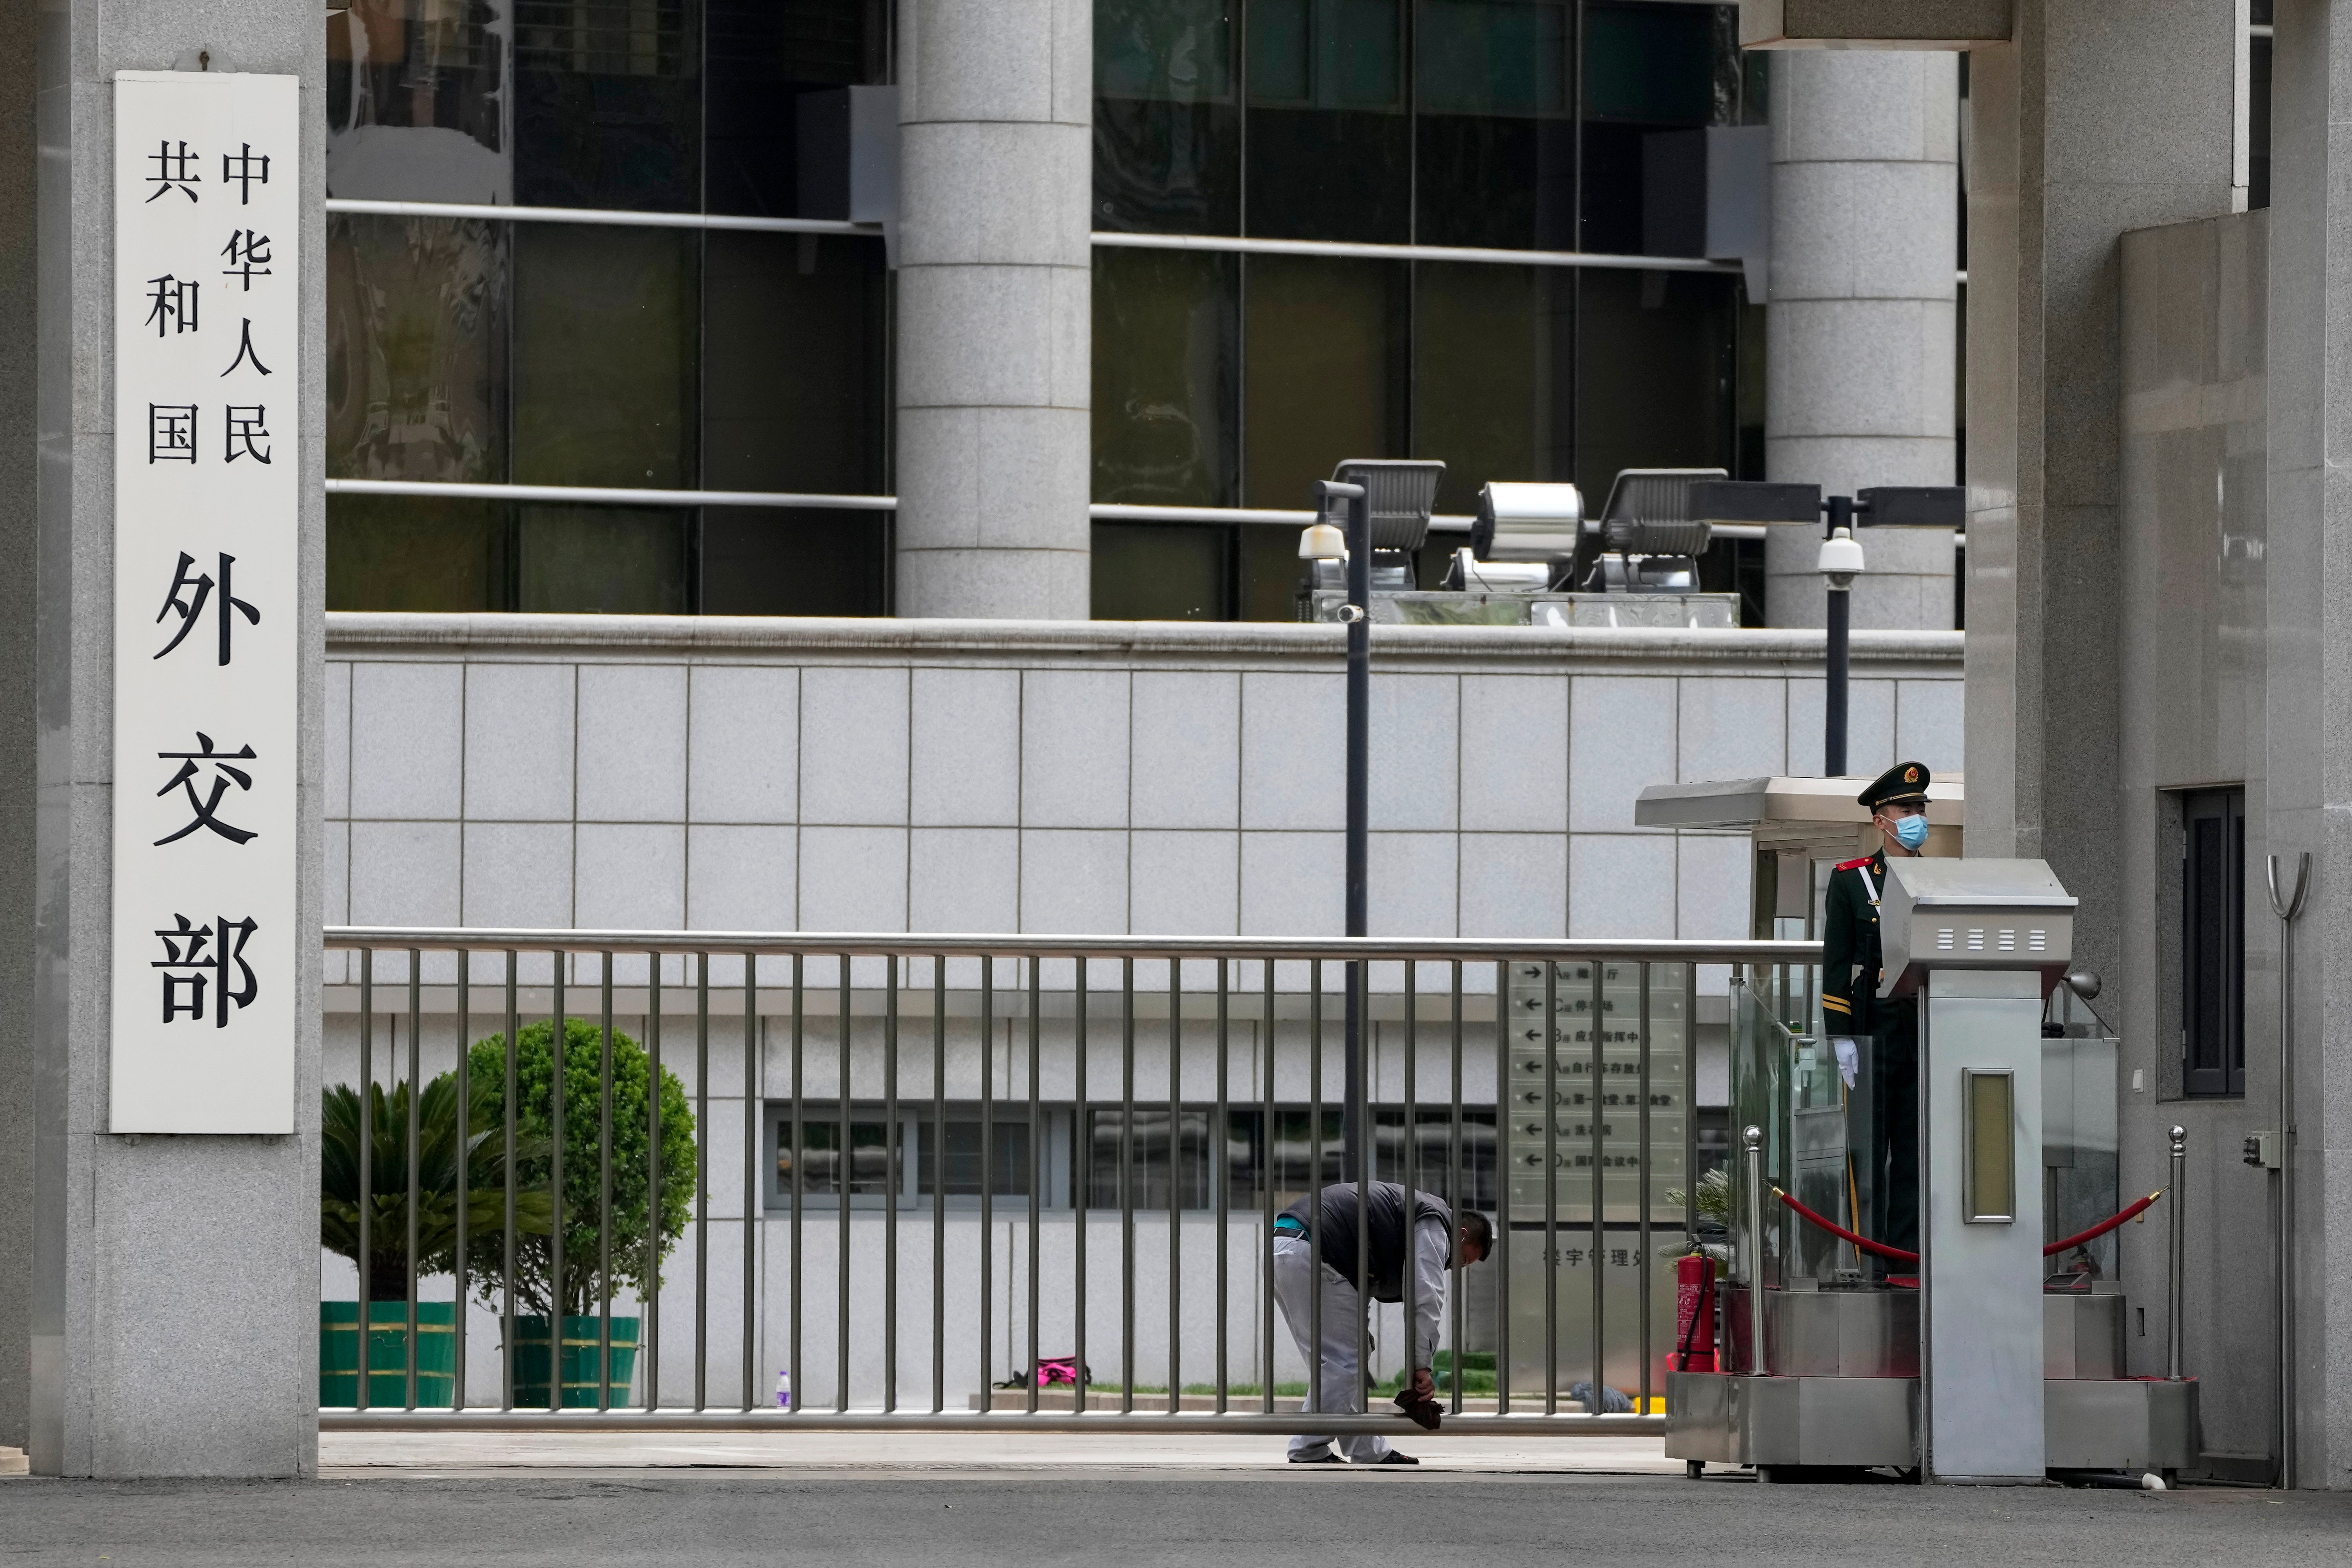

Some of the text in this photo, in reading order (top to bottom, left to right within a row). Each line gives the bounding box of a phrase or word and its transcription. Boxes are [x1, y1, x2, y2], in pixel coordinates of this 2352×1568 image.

[145, 140, 201, 465] 共和国
[221, 142, 272, 465] 中华人民
[151, 551, 260, 1028] 外交部
[1575, 1030, 1651, 1043] 应指挥中
